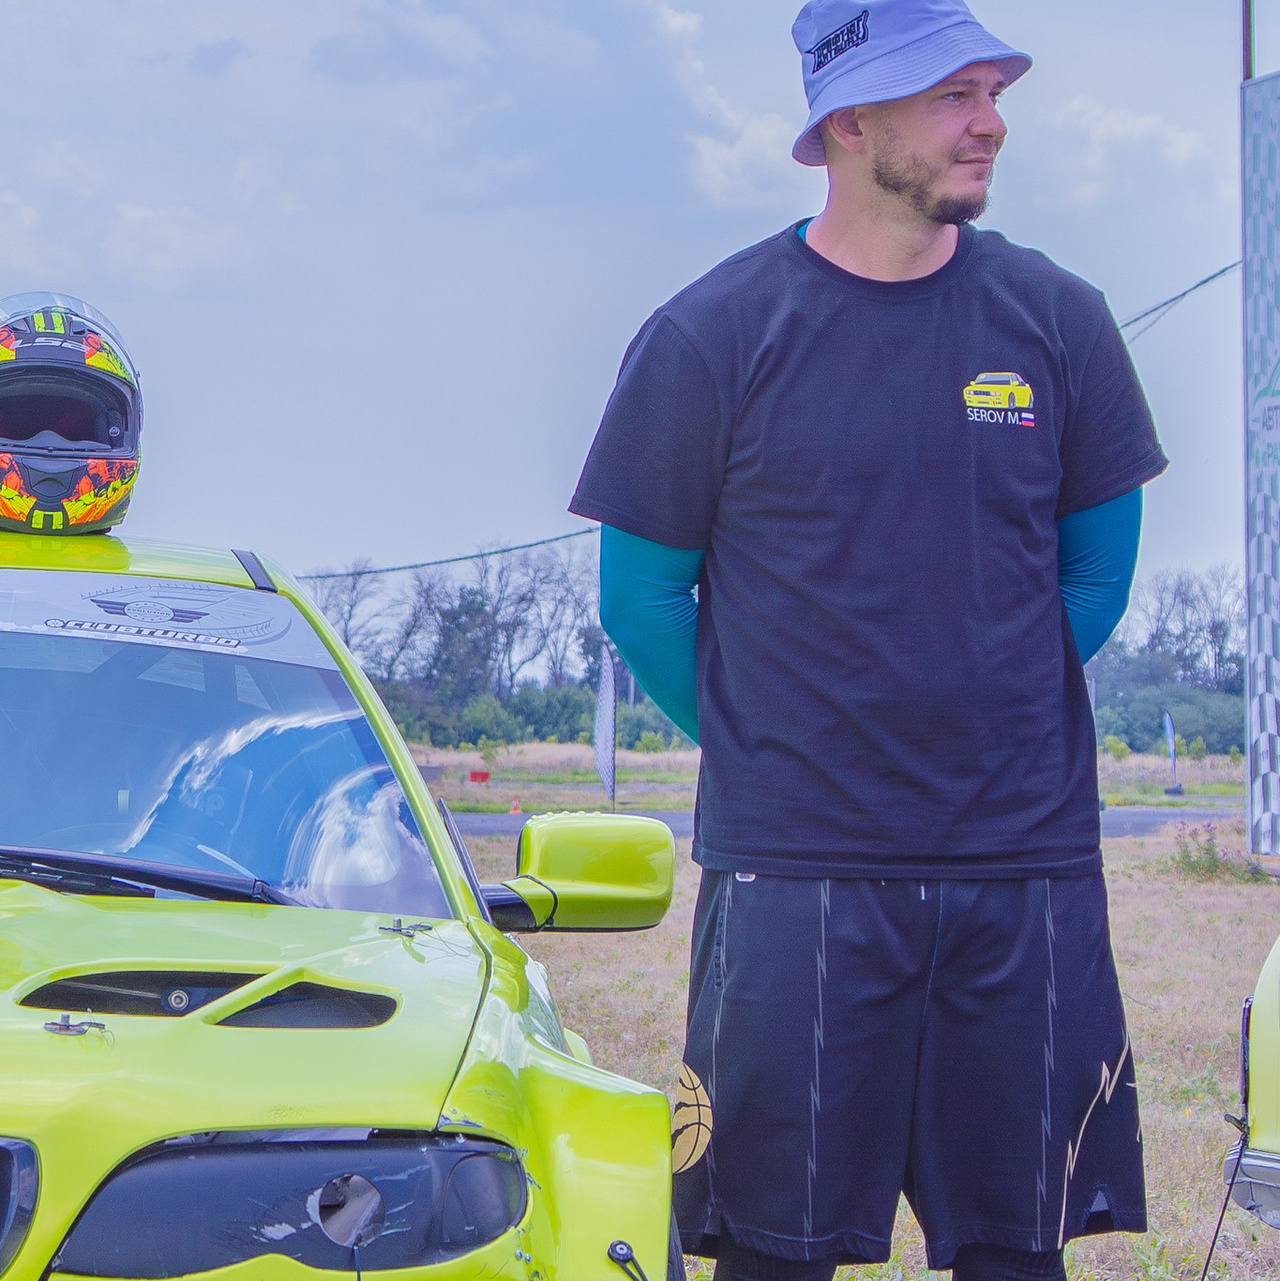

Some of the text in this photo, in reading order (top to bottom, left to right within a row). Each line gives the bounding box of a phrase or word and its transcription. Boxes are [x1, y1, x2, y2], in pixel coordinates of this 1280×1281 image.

[9, 337, 90, 353] LS2
[966, 407, 1022, 425] SEROV M.
